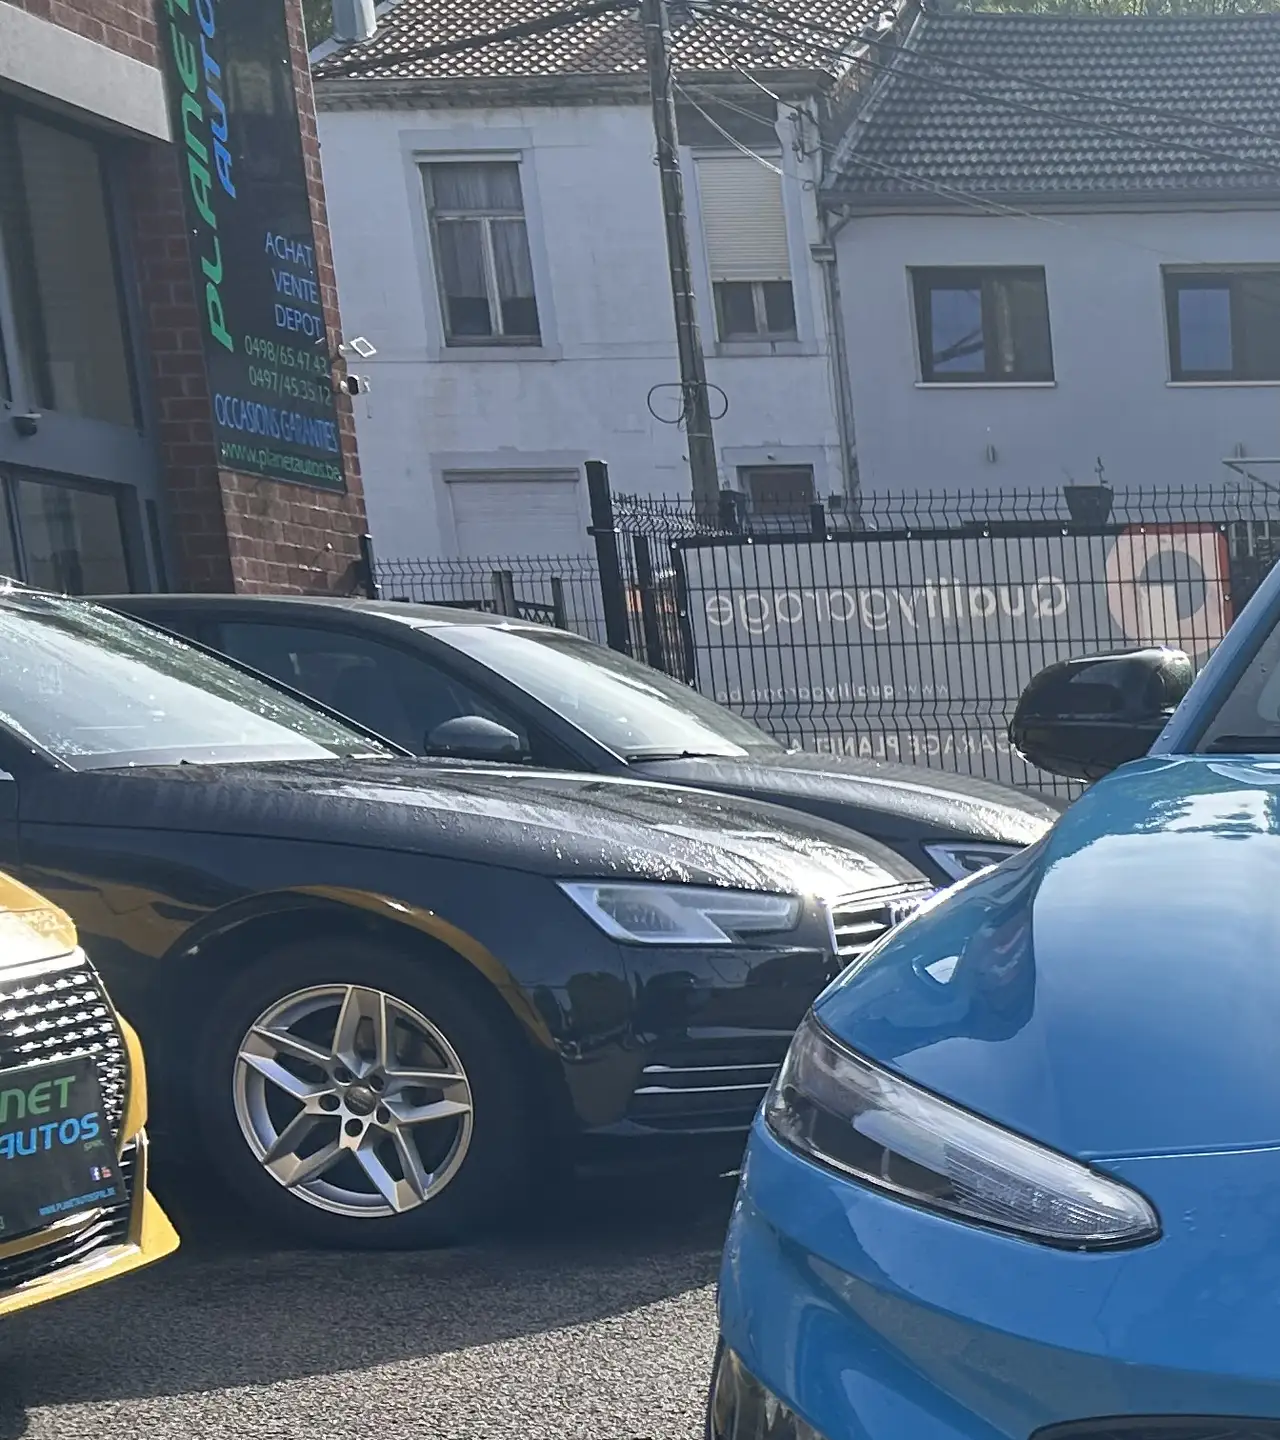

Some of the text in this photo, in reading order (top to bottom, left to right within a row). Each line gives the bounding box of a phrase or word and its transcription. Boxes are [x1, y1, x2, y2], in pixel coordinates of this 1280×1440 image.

[265, 231, 314, 268] ACHAT
[271, 268, 319, 305] VENTE
[274, 303, 322, 338] DEPOT
[215, 393, 281, 440] OCCASIONS
